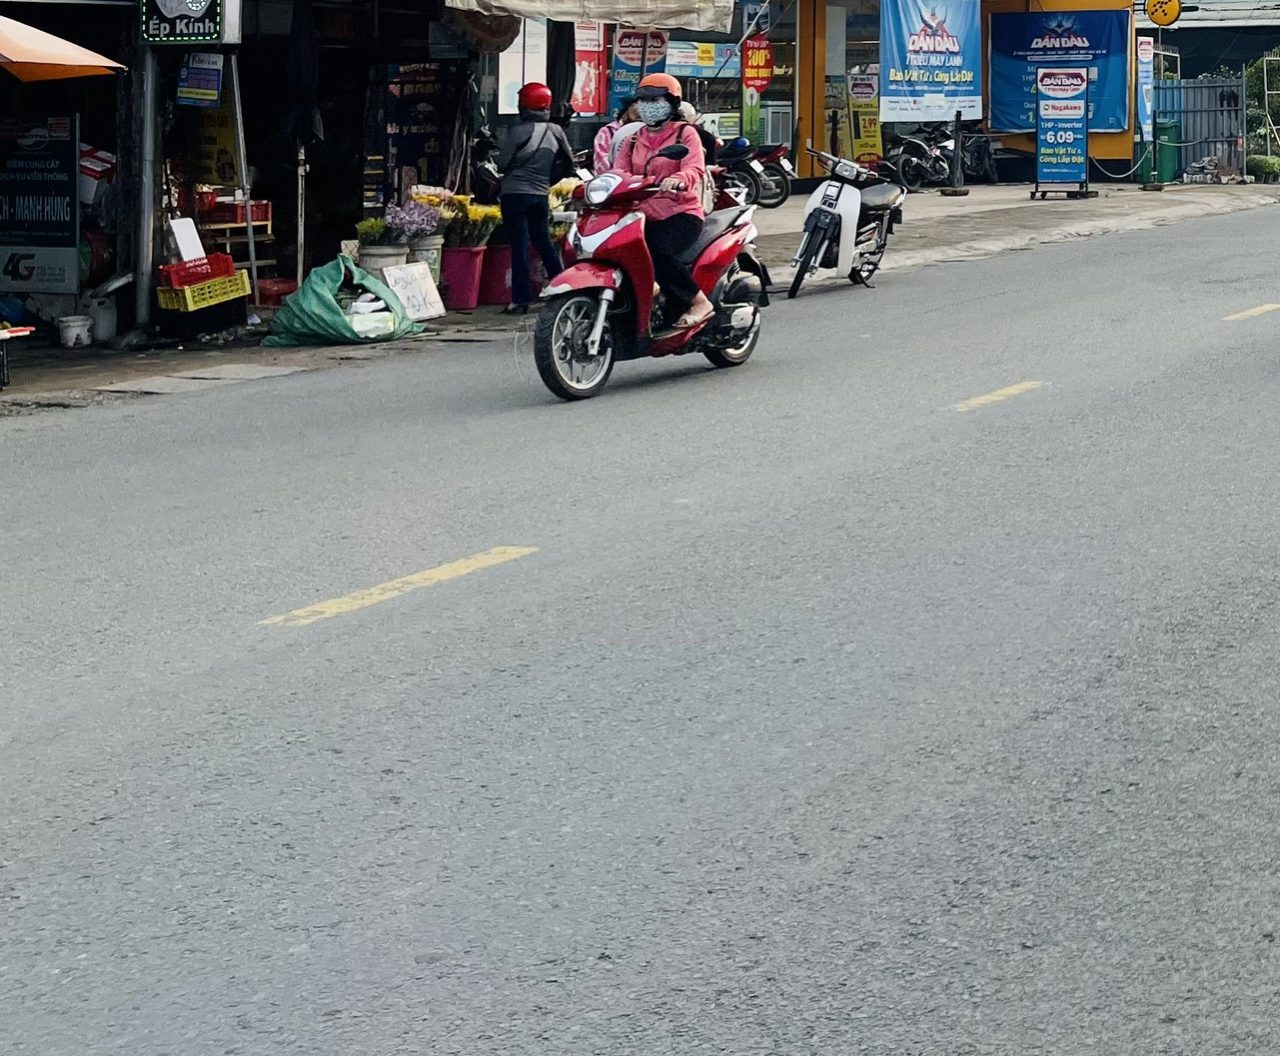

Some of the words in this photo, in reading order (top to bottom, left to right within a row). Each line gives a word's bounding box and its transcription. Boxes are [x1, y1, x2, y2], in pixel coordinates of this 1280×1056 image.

[149, 16, 171, 37] Ép
[175, 18, 215, 35] Kính
[1051, 103, 1082, 113] Nagakawa
[1046, 131, 1074, 144] 6,09
[1040, 147, 1054, 155] Bao
[2, 252, 36, 282] 4G
